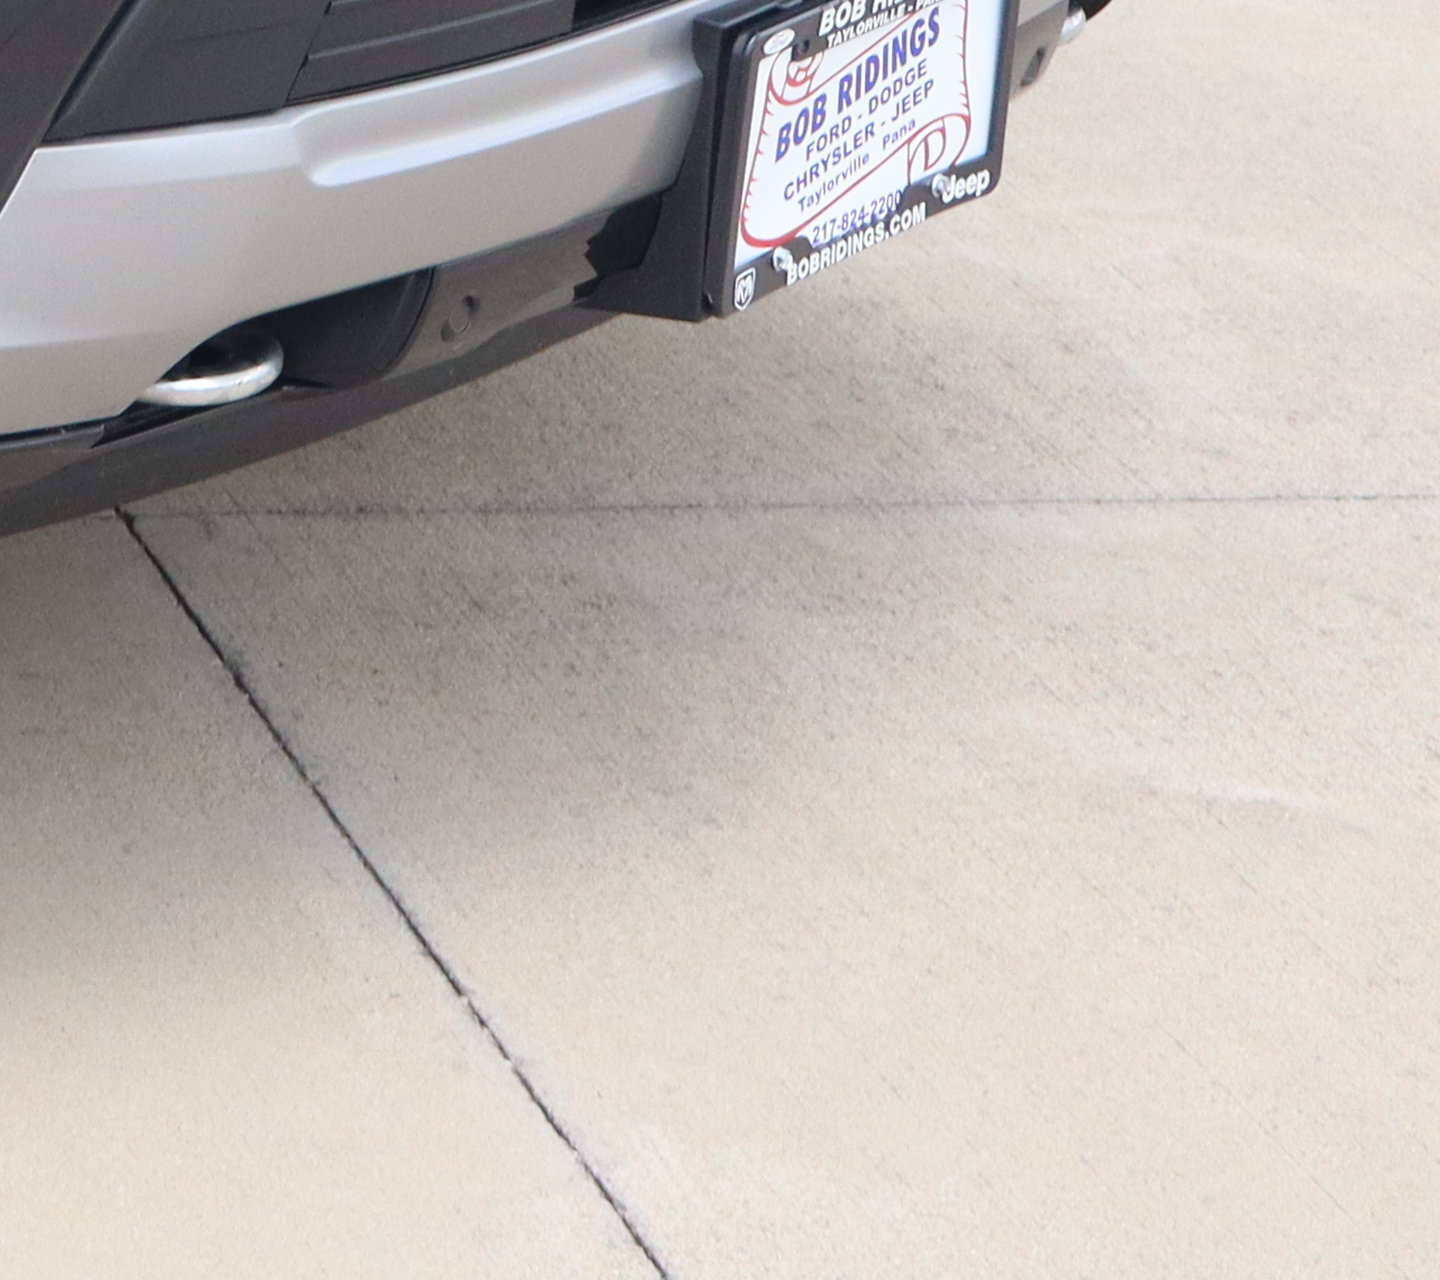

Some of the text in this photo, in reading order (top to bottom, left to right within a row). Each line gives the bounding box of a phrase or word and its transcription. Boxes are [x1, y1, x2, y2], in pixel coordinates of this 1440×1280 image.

[827, 3, 906, 49] TAYLORVILLE
[775, 7, 941, 163] BOB RIDINGS
[805, 116, 853, 161] FORD
[868, 58, 929, 115] DODGE
[783, 121, 876, 201] CHRYSLER
[891, 79, 935, 123] JEEP
[797, 118, 917, 213] Taylorville Pana
[942, 168, 991, 204] Jeep
[786, 201, 927, 286] BOBRIDINGS.COM
